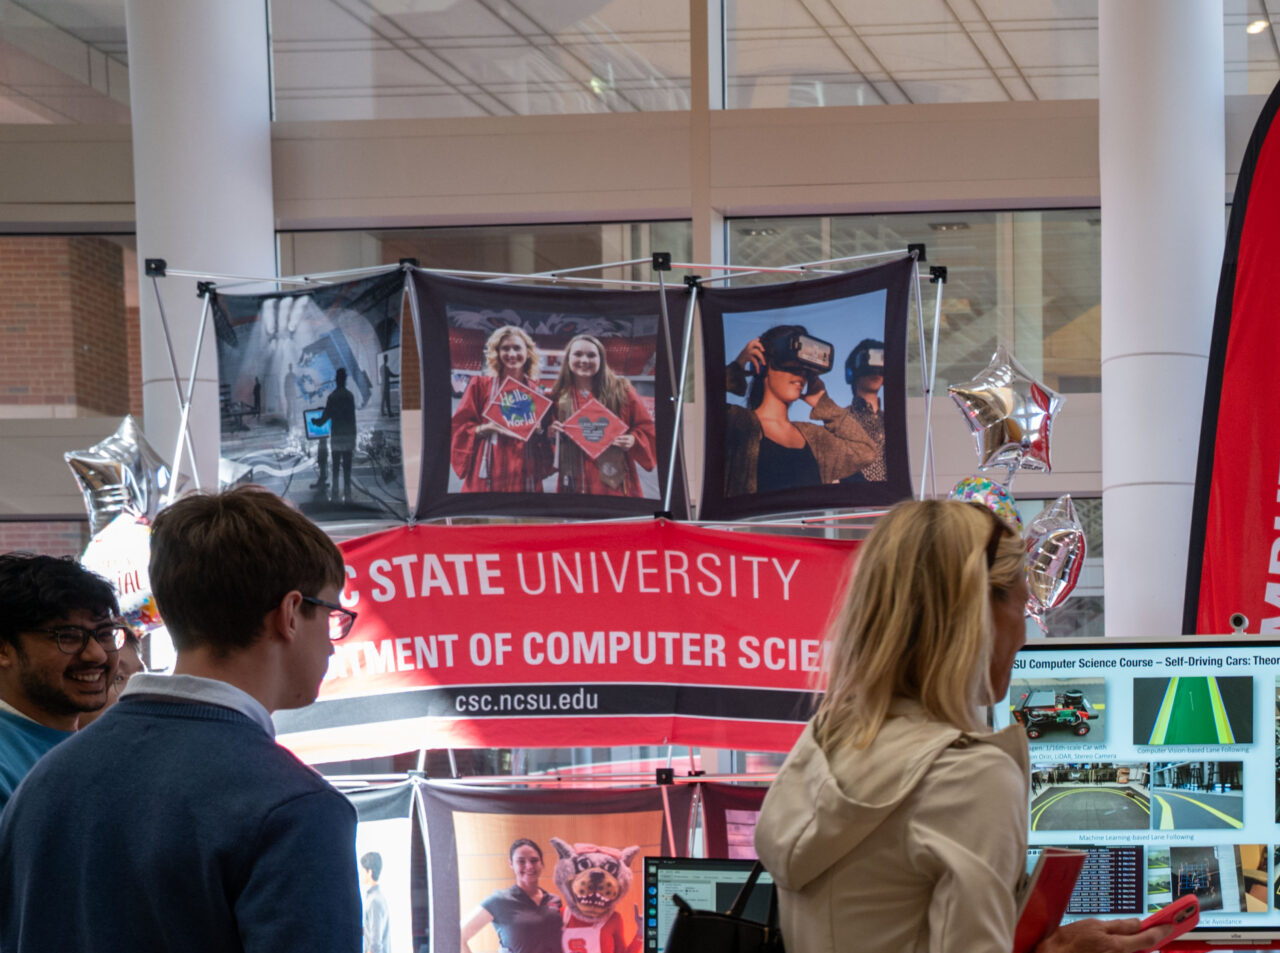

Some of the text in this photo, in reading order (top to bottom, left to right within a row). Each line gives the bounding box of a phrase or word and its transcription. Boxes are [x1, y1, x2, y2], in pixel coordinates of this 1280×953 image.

[339, 550, 801, 608] C STATE UNIVERSITY
[469, 632, 513, 667] OF
[523, 631, 727, 667] COMPUTER
[738, 635, 832, 672] SCIE
[1013, 660, 1026, 669] SU
[1029, 659, 1076, 670] Computer
[1079, 658, 1118, 668] Science
[1120, 658, 1153, 668] Course
[1165, 656, 1223, 668] Self-Driving
[1226, 656, 1251, 666] Cars:
[455, 688, 599, 711] csc.ncsu.edu
